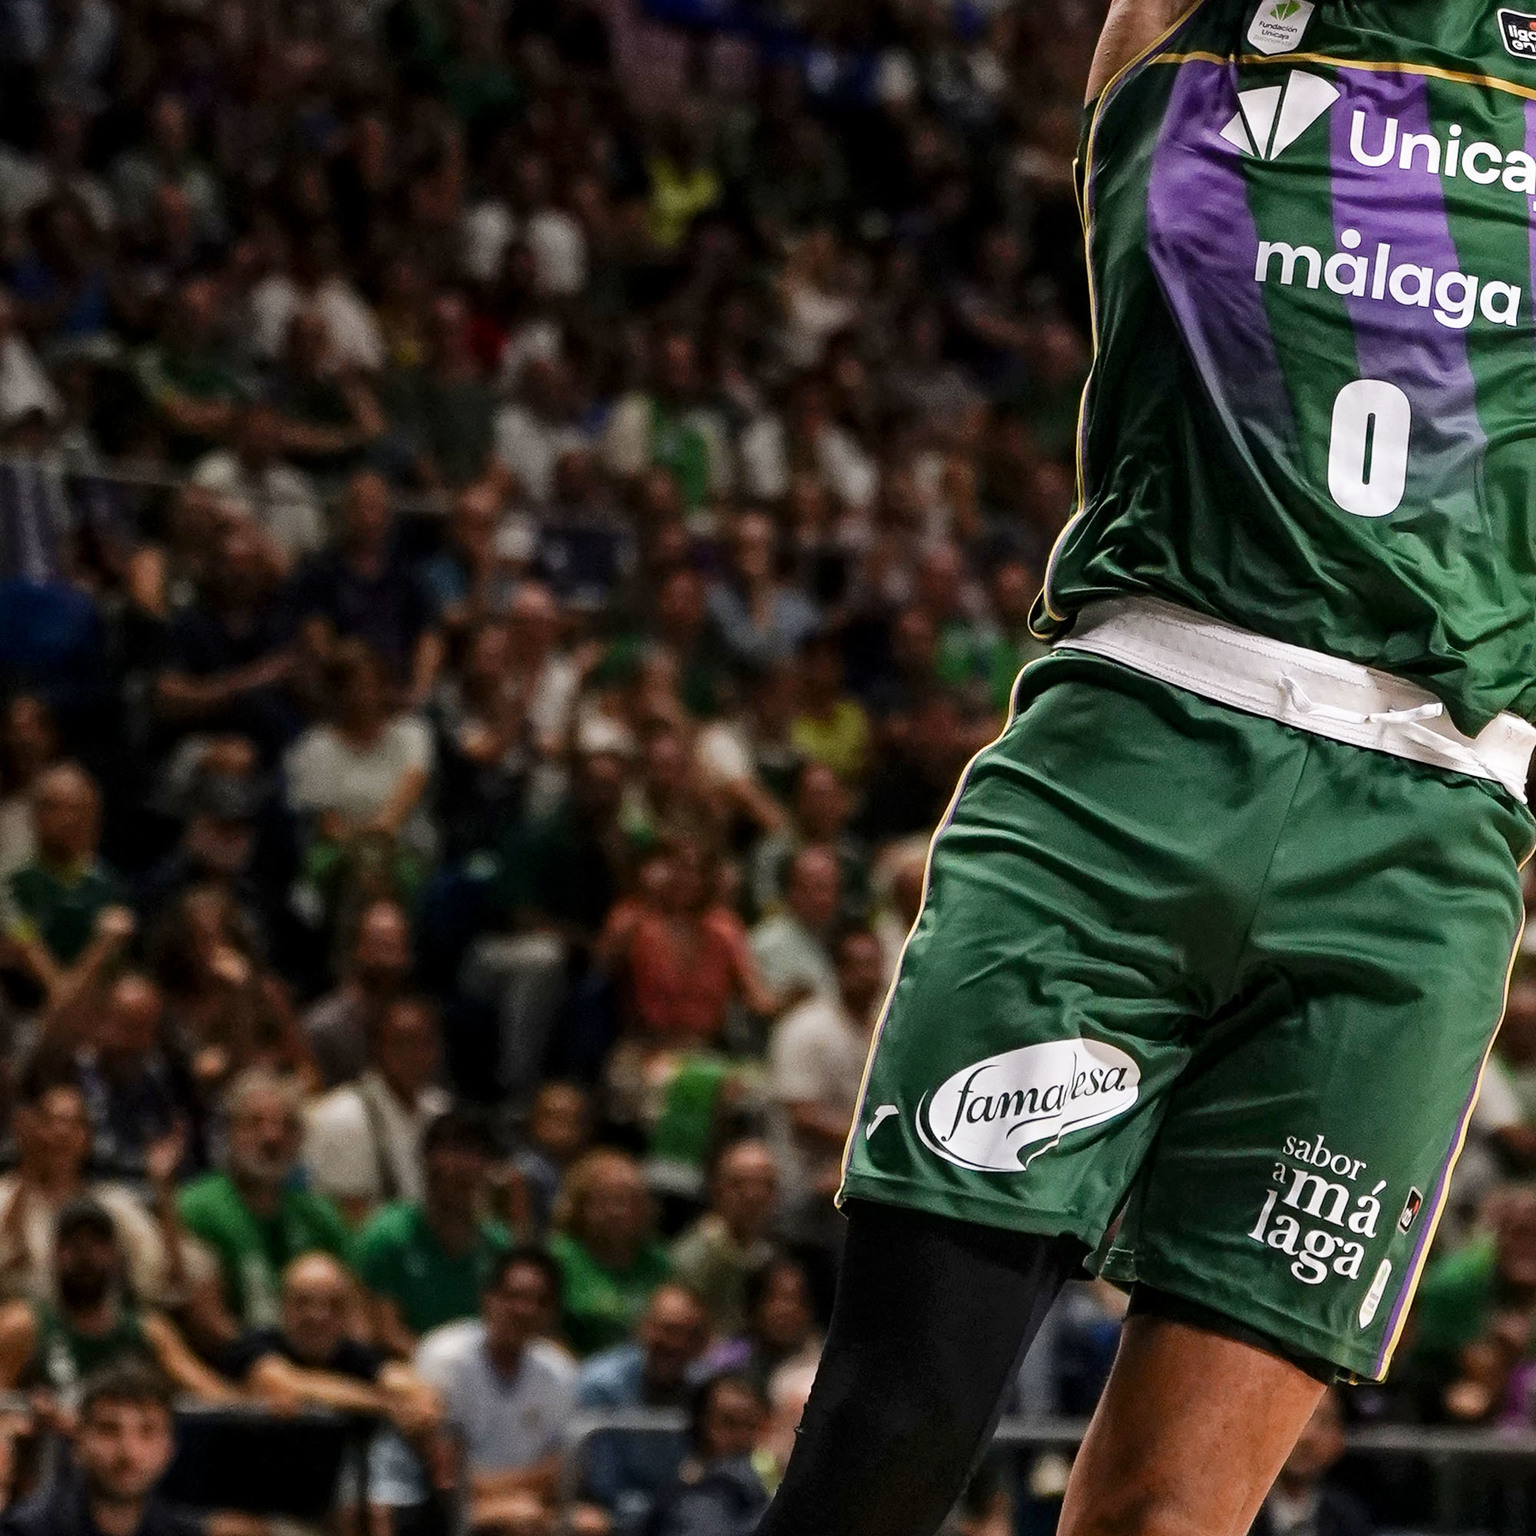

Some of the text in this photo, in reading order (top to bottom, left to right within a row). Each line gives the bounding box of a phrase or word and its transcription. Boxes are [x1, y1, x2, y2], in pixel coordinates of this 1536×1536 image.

[1327, 378, 1412, 517] 0
[1282, 1134, 1367, 1181] sabor
[1248, 1189, 1365, 1285] laga
